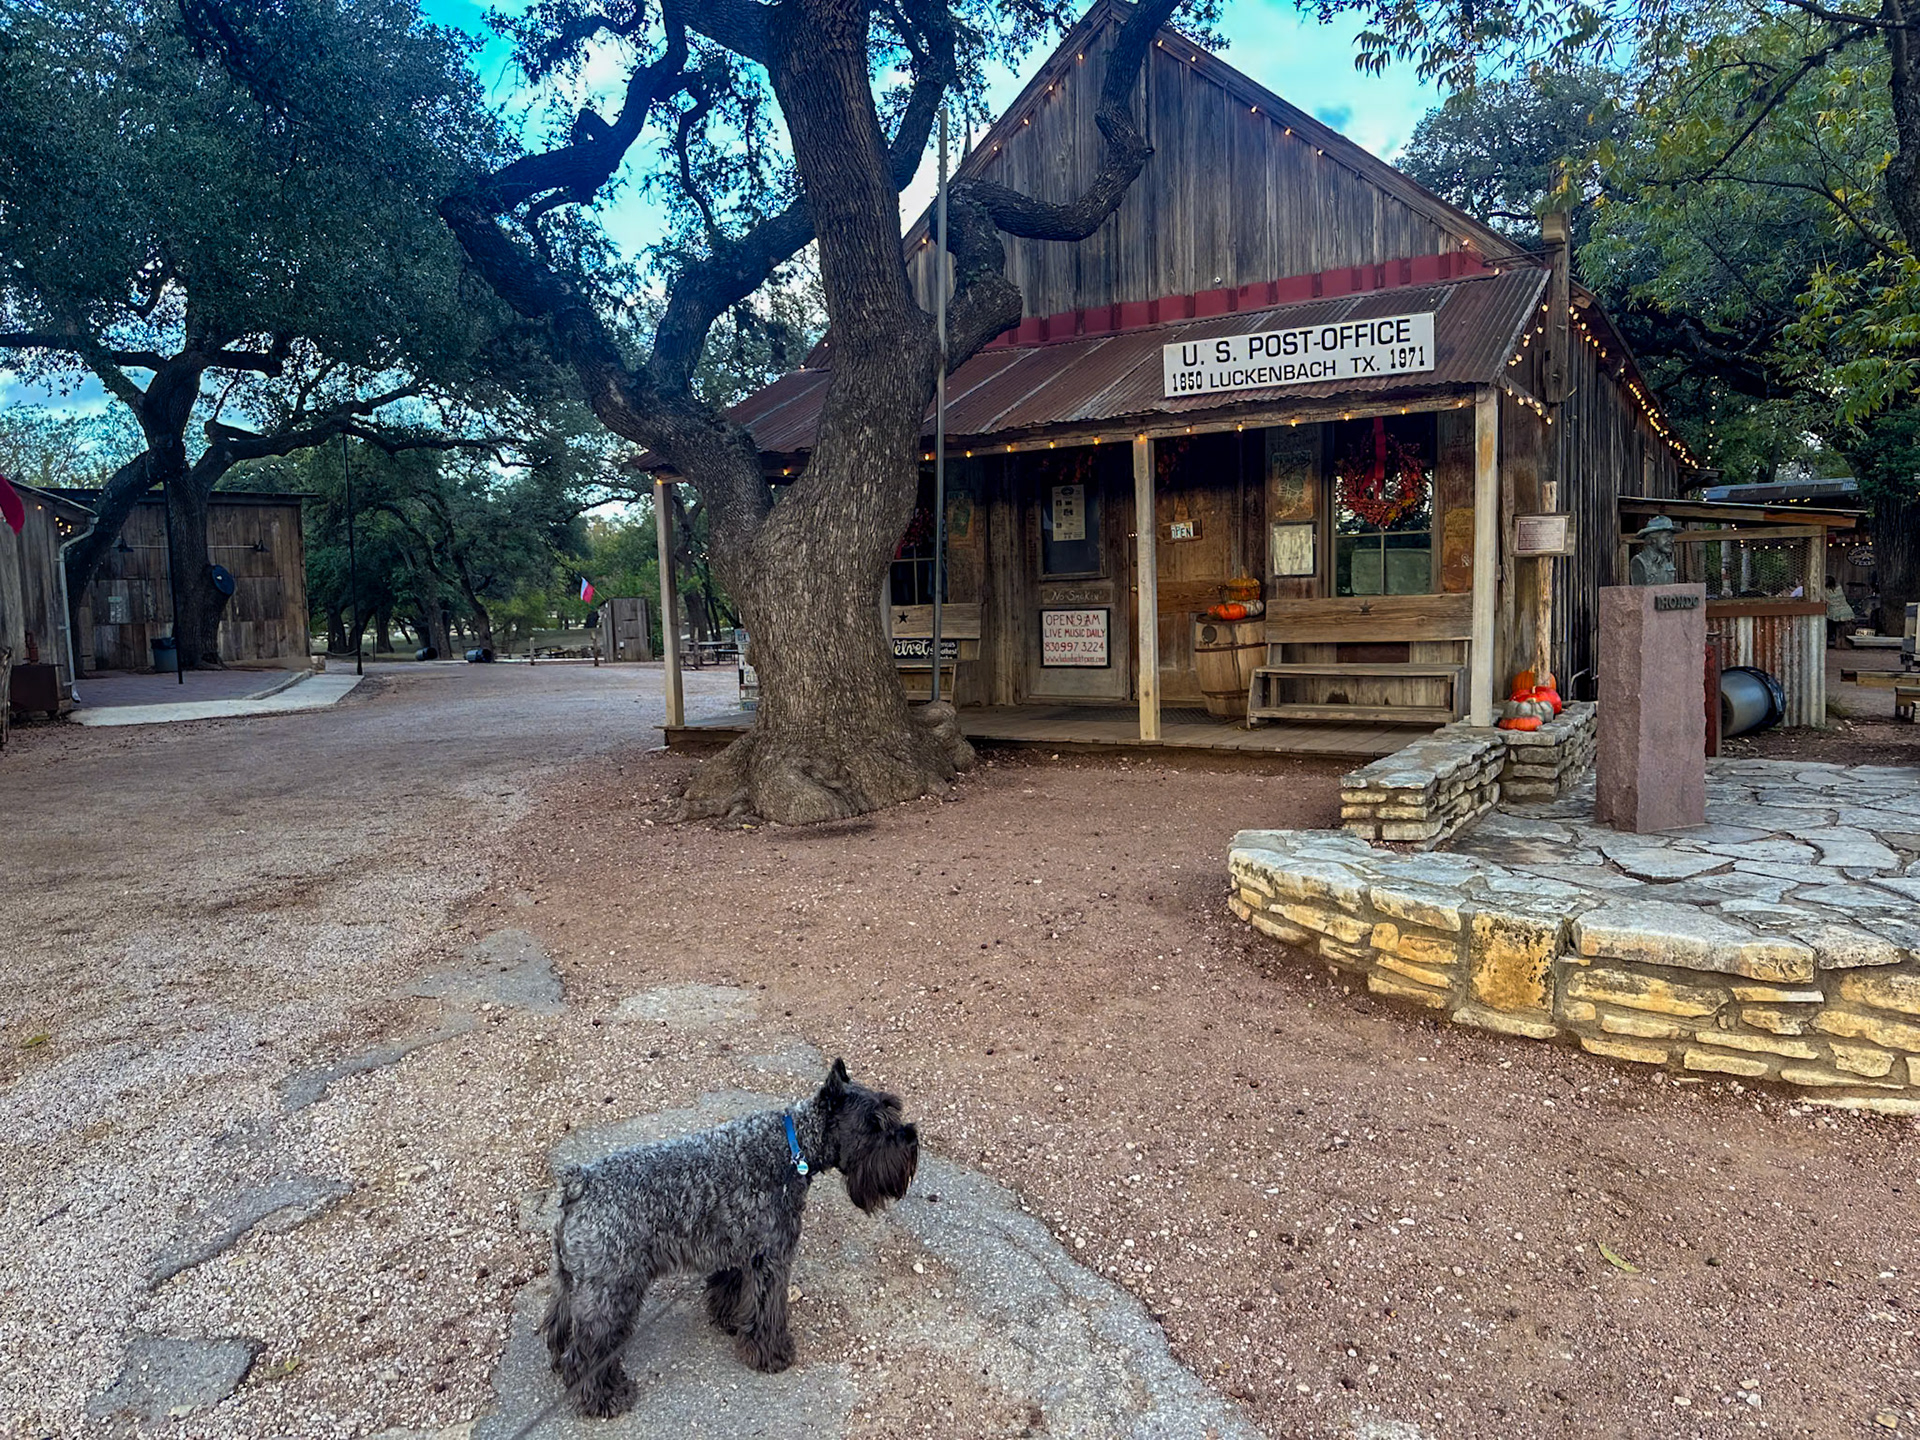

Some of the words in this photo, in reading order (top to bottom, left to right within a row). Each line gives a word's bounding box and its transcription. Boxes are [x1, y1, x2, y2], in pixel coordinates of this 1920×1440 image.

[1182, 344, 1205, 366] U.
[1216, 341, 1237, 363] S.
[1249, 319, 1411, 359] POST-OFFICE
[1172, 371, 1203, 392] 1850
[1210, 360, 1336, 388] LUCKENBACH
[1350, 356, 1381, 373] TX.
[1390, 346, 1425, 369] 1971
[1656, 594, 1700, 610] HONDO
[1045, 614, 1074, 626] OPEN
[1076, 614, 1083, 625] 9
[1084, 614, 1101, 626] AM
[1044, 628, 1062, 638] LIVE
[1064, 628, 1085, 638] MUSIC
[1086, 628, 1106, 638] DAILY
[1081, 641, 1105, 652] 3224
